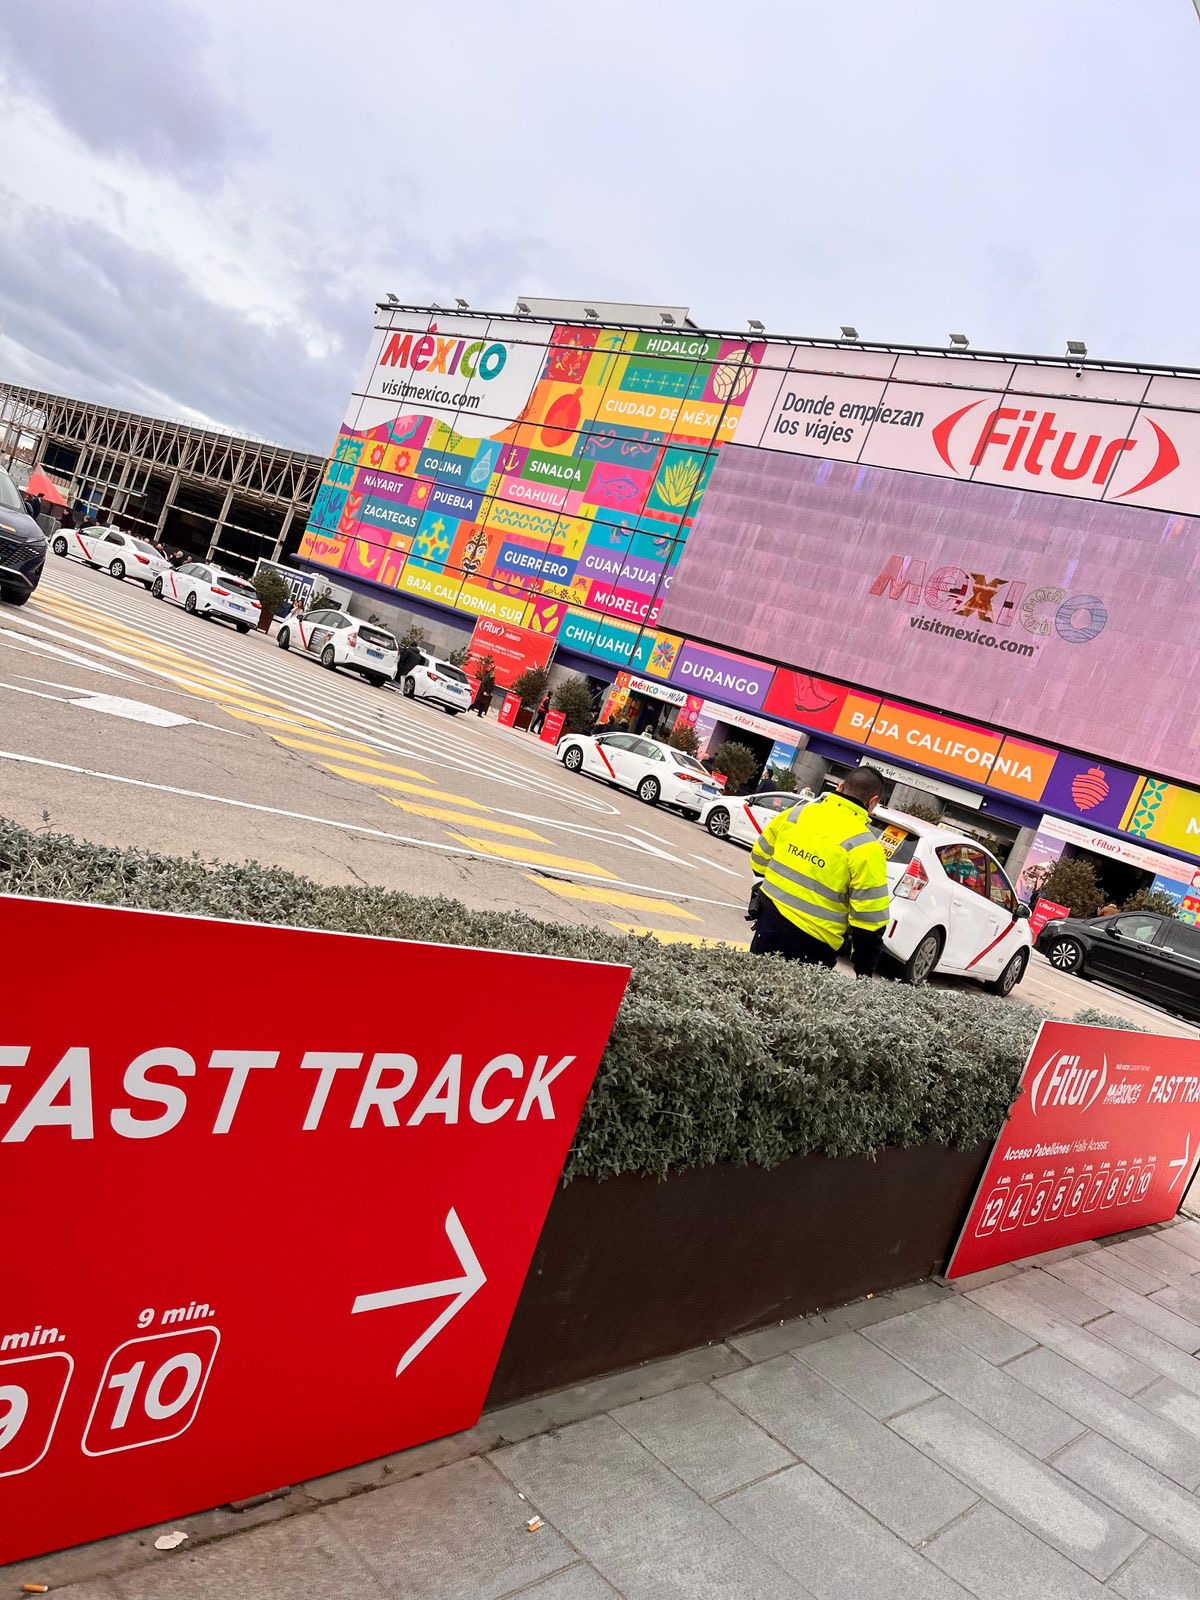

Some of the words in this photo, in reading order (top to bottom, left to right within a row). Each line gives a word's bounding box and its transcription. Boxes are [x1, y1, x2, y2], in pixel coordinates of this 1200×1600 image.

[646, 338, 710, 356] HIDALGO
[381, 380, 480, 409] visitmexico.com
[605, 400, 656, 417] CIUDAD
[660, 407, 679, 420] DE
[682, 409, 738, 430] MÉXICO
[782, 391, 835, 418] Donde
[839, 401, 925, 428] empiezan
[773, 413, 799, 437] los
[805, 421, 854, 446] viajes
[424, 458, 462, 475] COLIMA
[529, 461, 582, 482] SINALOA
[363, 476, 404, 494] NAYARIT
[508, 484, 568, 508] COAHUILA
[433, 491, 473, 510] PUEBLA
[364, 505, 418, 528] ZACATECAS
[504, 551, 568, 577] GUERRERO
[585, 555, 673, 589] GUANAJUAO
[406, 576, 432, 593] BAJA
[434, 582, 497, 615] CALIFORNIA
[500, 606, 522, 623] SUR
[594, 591, 659, 620] MORELOS
[565, 625, 643, 660] CHIHUAHUA
[910, 616, 1034, 657] visitmexico.com
[680, 660, 759, 696] DURANGO
[850, 711, 900, 740] BAJA
[906, 730, 1034, 783] CALIFORNIA
[300, 1051, 577, 1131] TRACK
[1146, 1075, 1184, 1104] FAST
[1003, 1146, 1033, 1161] Acceso
[1072, 1183, 1084, 1207] 6
[1090, 1180, 1103, 1203] 7
[1107, 1177, 1119, 1200] 8
[1123, 1175, 1134, 1197] 9
[1137, 1172, 1151, 1194] 10
[1009, 1194, 1023, 1220] 4
[1031, 1190, 1045, 1216] 3
[1052, 1186, 1067, 1211] 5
[982, 1198, 1004, 1227] 12
[136, 1308, 155, 1328] 9
[160, 1301, 215, 1325] min.
[0, 1325, 66, 1351] min.
[108, 1352, 202, 1430] 10
